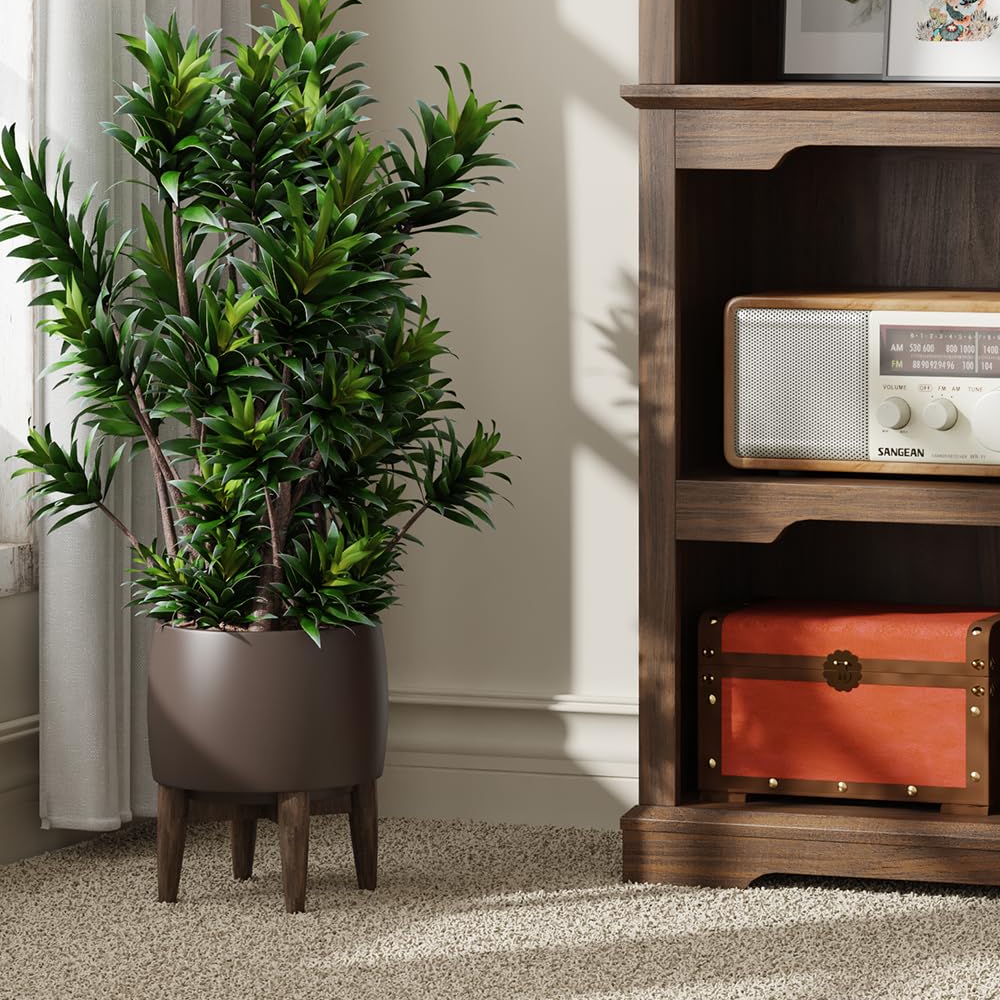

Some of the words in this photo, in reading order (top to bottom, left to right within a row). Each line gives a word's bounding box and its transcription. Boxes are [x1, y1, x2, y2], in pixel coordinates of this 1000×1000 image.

[890, 344, 904, 352] AM
[909, 344, 921, 352] 530
[923, 344, 935, 352] 600
[945, 344, 958, 353] 800
[960, 345, 975, 353] 1000
[891, 360, 903, 368] FM
[913, 360, 920, 369] 88
[962, 361, 974, 370] 100
[981, 362, 993, 370] 104
[878, 447, 925, 458] SANGEAN
